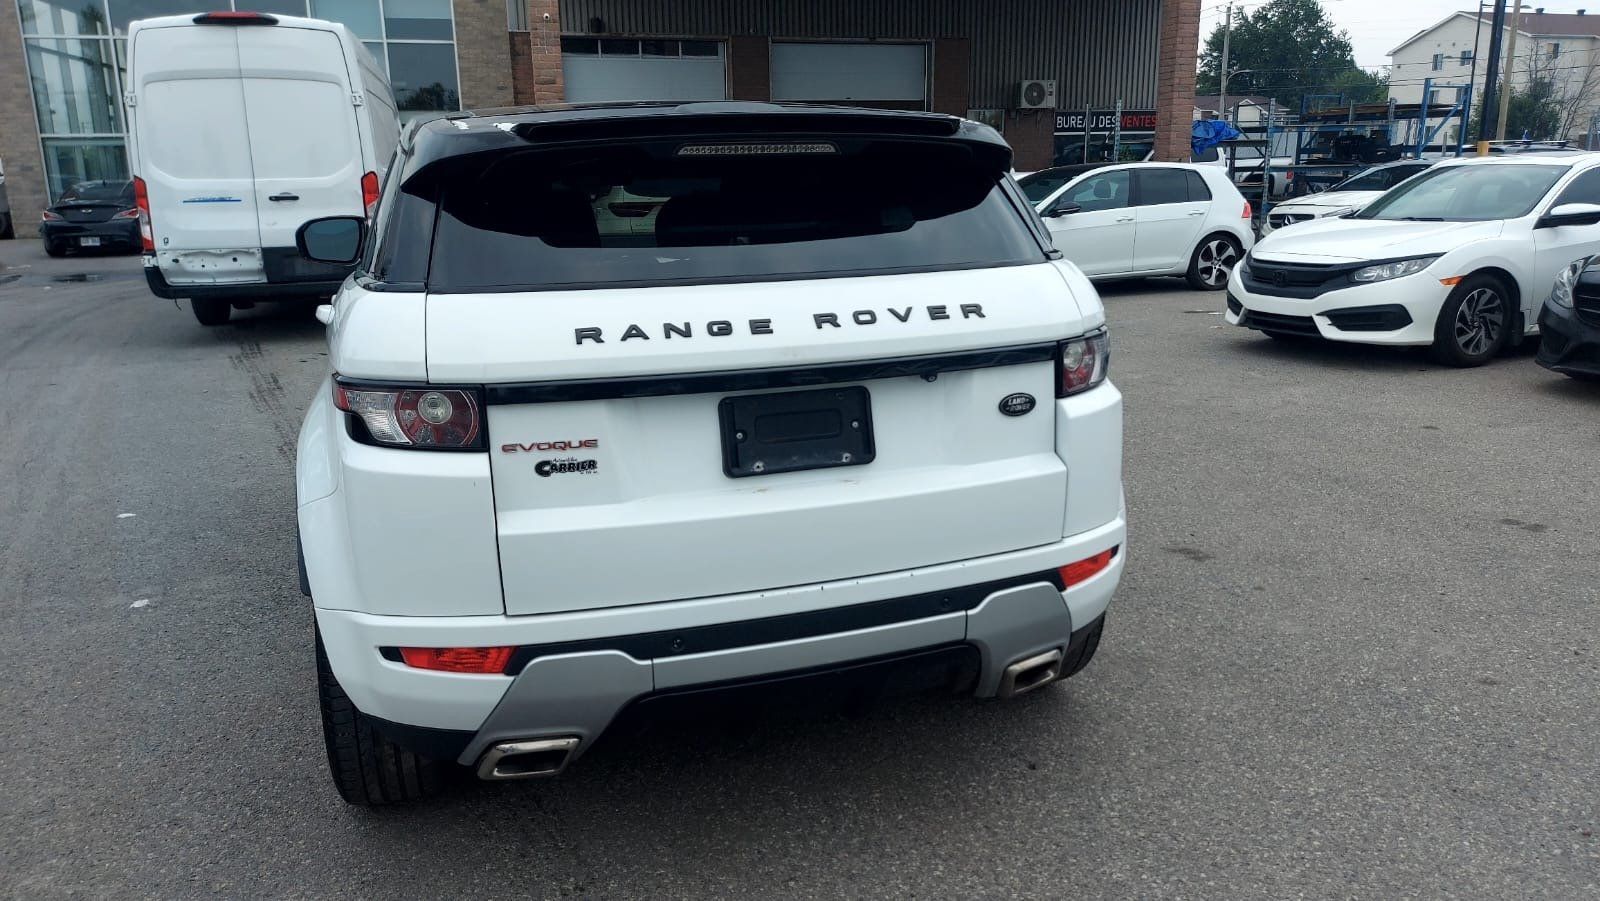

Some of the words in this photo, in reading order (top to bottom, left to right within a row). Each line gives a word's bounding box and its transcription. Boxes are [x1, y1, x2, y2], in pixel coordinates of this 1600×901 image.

[1098, 115, 1116, 128] DES
[1119, 114, 1156, 128] VENTES
[574, 318, 774, 345] RANGE
[813, 303, 986, 329] ROVER
[501, 439, 598, 453] EVOQUE
[534, 459, 598, 477] CARRIER
